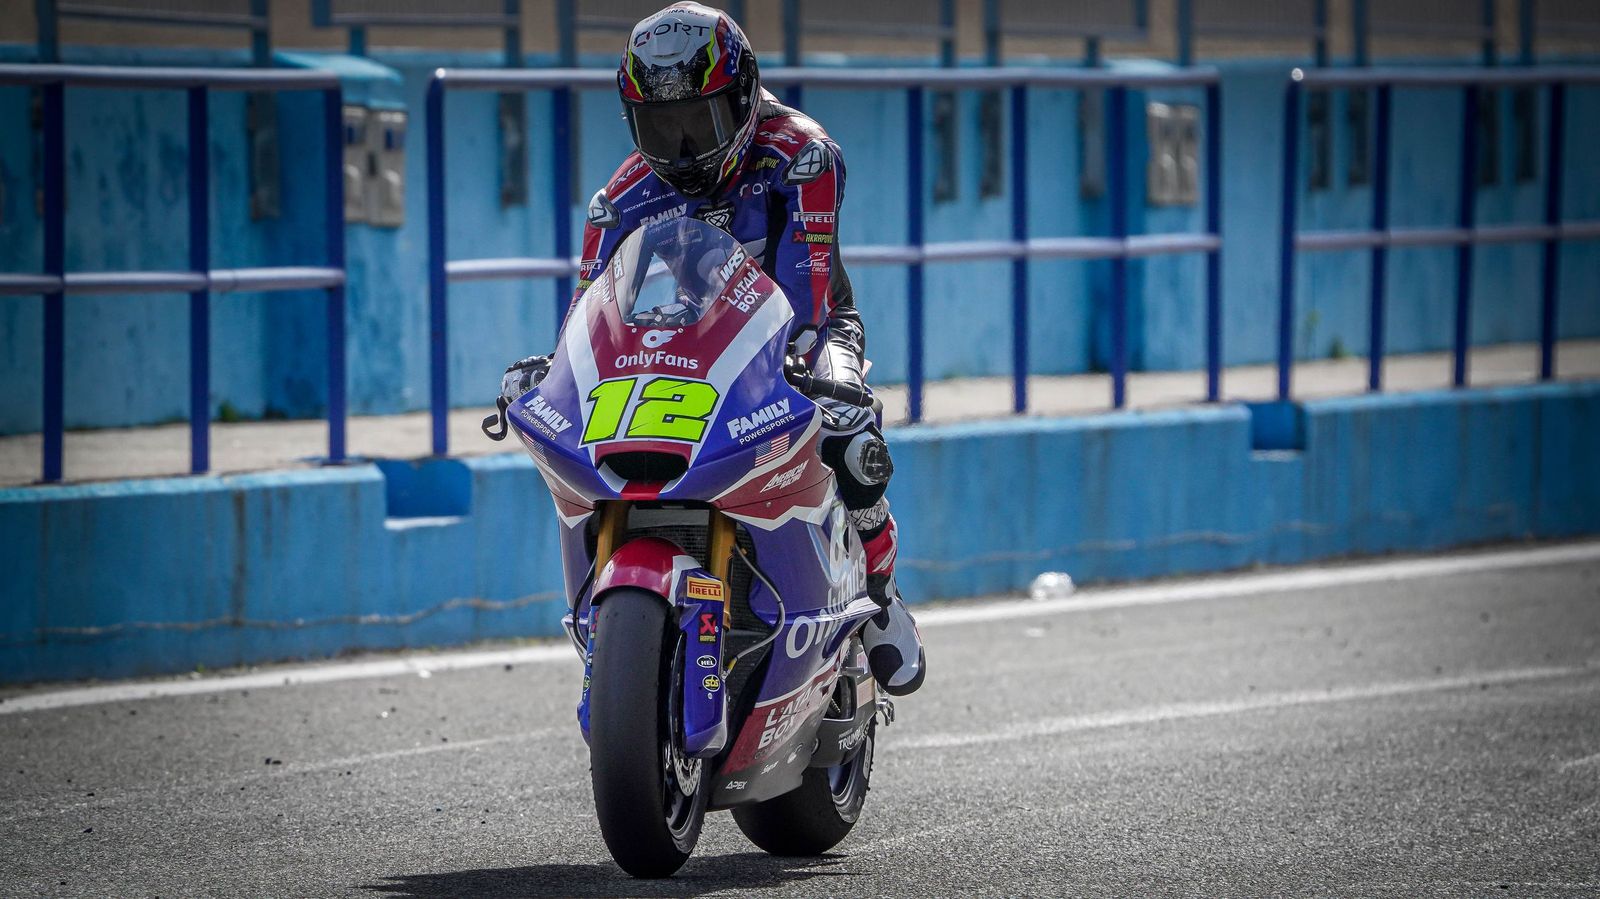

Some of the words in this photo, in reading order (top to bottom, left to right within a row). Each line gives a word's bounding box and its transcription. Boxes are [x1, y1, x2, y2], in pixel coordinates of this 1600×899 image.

[623, 195, 661, 214] SCORPION
[640, 203, 688, 226] FAMILY
[720, 246, 745, 282] WRS
[726, 266, 760, 306] LATAM
[737, 287, 761, 313] BOX
[615, 350, 699, 370] OnlyFans
[520, 409, 557, 441] POWERSPORTS
[524, 395, 573, 433] FAMILY
[580, 376, 720, 445] 12
[726, 397, 790, 440] FAMILY
[739, 413, 796, 446] POWERSPORTS
[689, 580, 722, 597] PIRELLI
[725, 781, 747, 790] APEX
